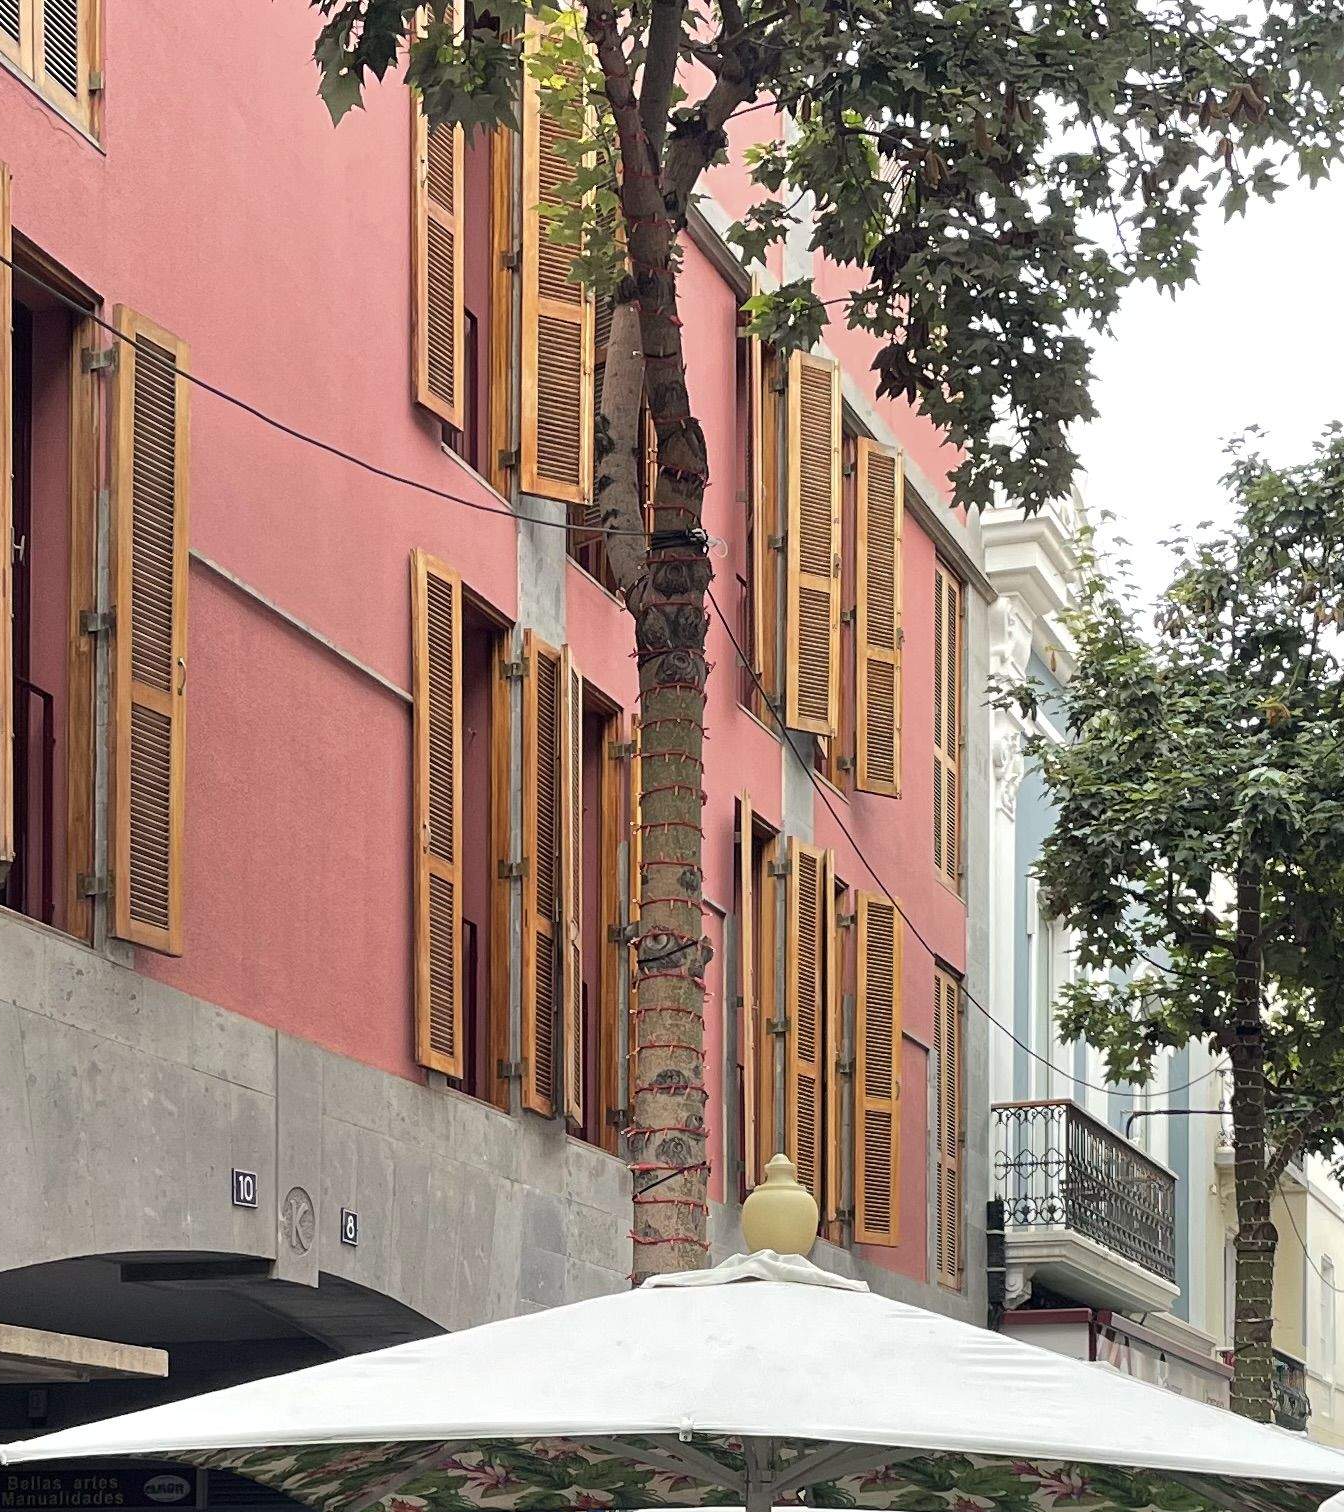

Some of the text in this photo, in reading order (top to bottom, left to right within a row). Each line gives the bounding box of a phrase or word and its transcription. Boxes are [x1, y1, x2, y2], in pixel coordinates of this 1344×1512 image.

[238, 1175, 253, 1201] 10
[346, 1215, 354, 1239] 8
[7, 1475, 119, 1490] Bellas artes
[1, 1490, 124, 1506] Manualidades
